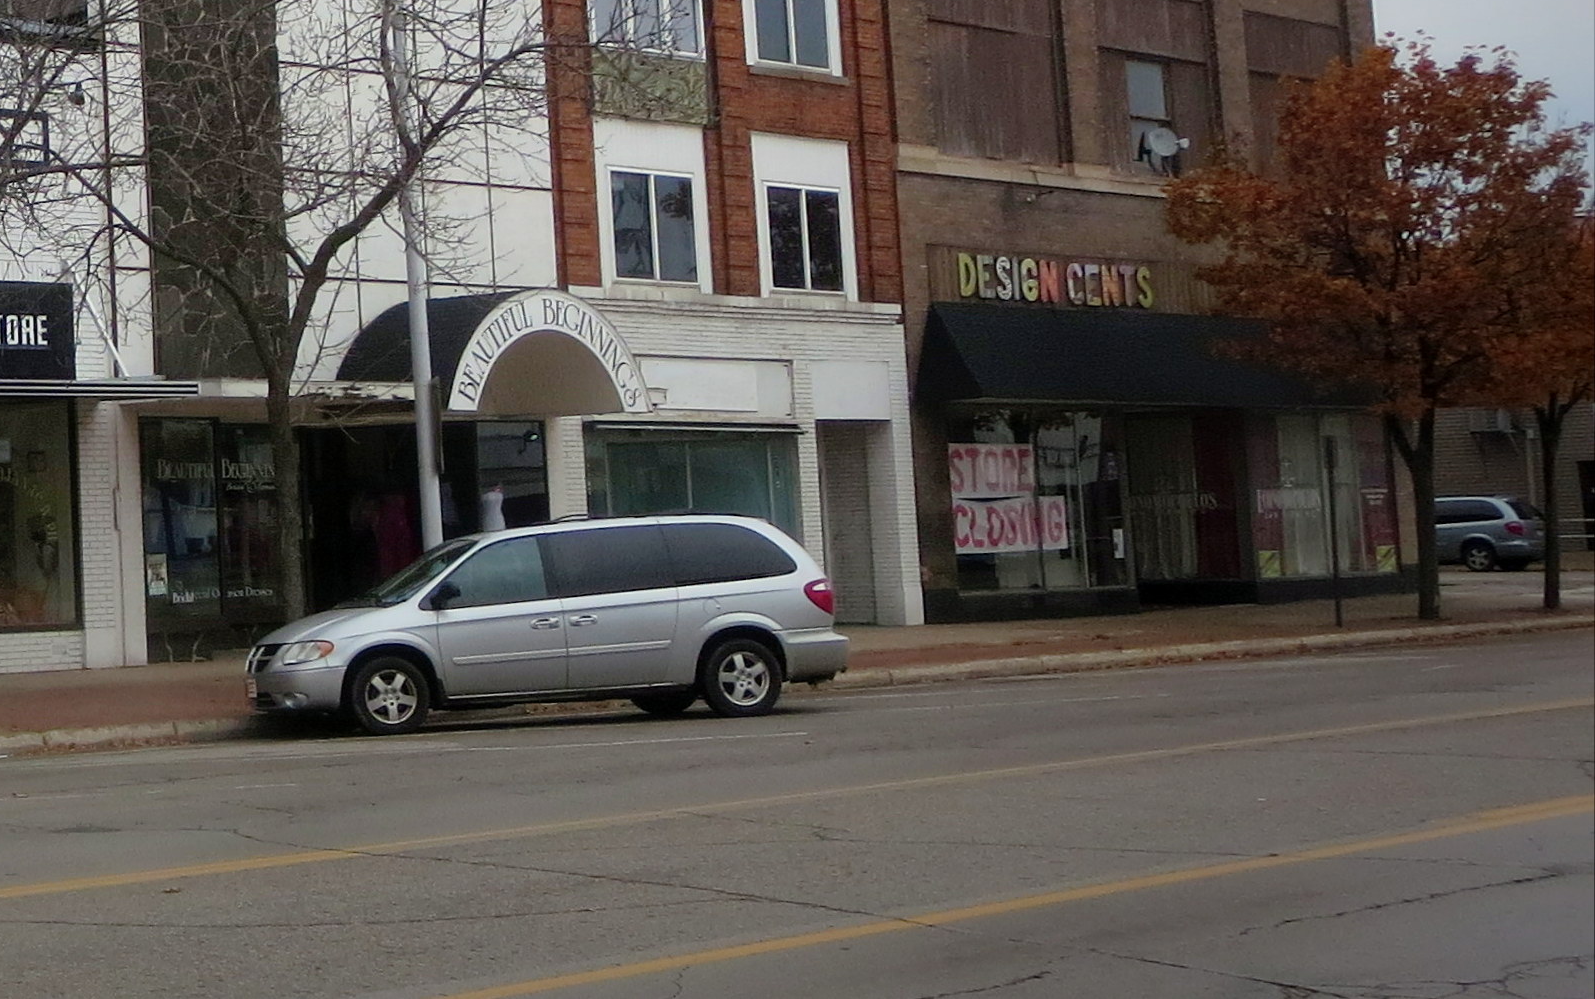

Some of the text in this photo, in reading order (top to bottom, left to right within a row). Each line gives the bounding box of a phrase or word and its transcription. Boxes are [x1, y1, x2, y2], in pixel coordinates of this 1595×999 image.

[957, 252, 1154, 309] DESIGN CENTS
[457, 298, 642, 408] BEAUTIFUL BEGINNINGS
[949, 447, 1036, 493] STORE
[952, 501, 1063, 548] CLOSING
